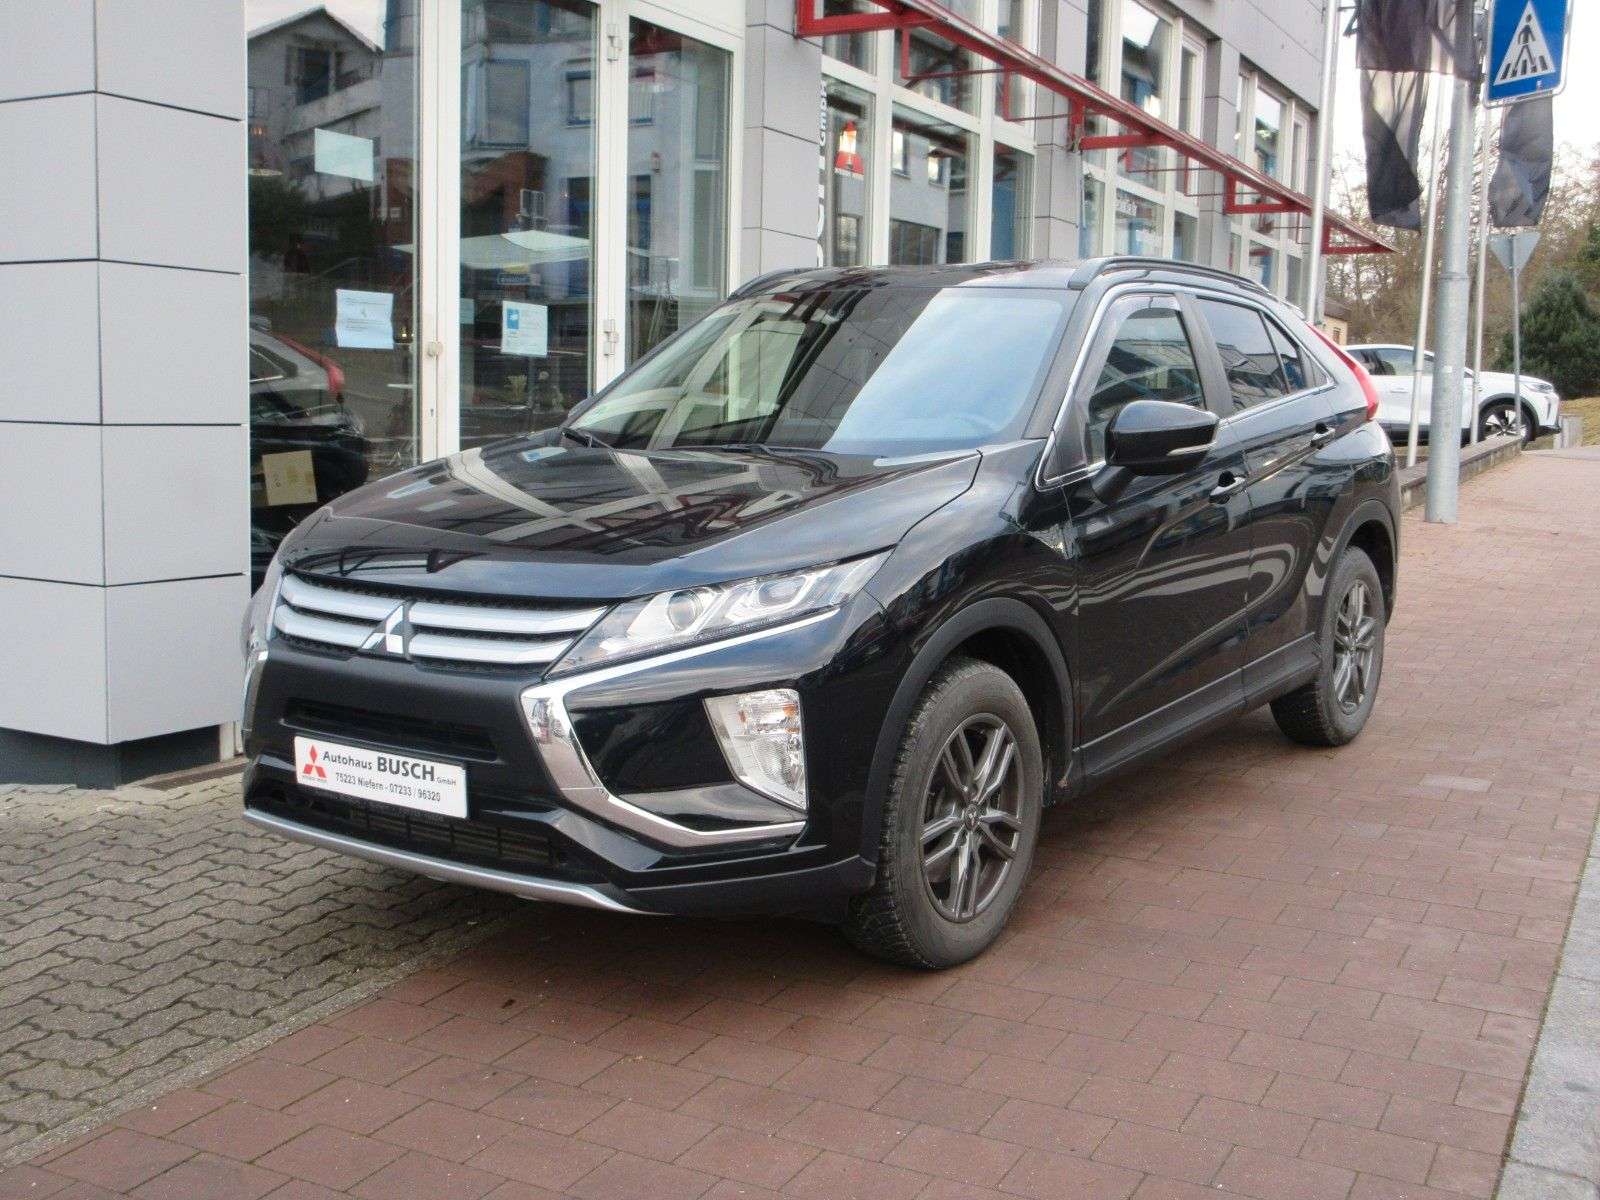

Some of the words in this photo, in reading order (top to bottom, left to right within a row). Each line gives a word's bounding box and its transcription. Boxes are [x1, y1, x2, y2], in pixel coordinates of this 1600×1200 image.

[322, 751, 373, 771] Autohaus
[377, 757, 435, 782] BUSCH
[437, 777, 457, 786] GmbH
[335, 772, 356, 785] 75223
[358, 777, 384, 791] Niefern
[389, 784, 412, 797] 07233
[418, 788, 441, 802] 96320
